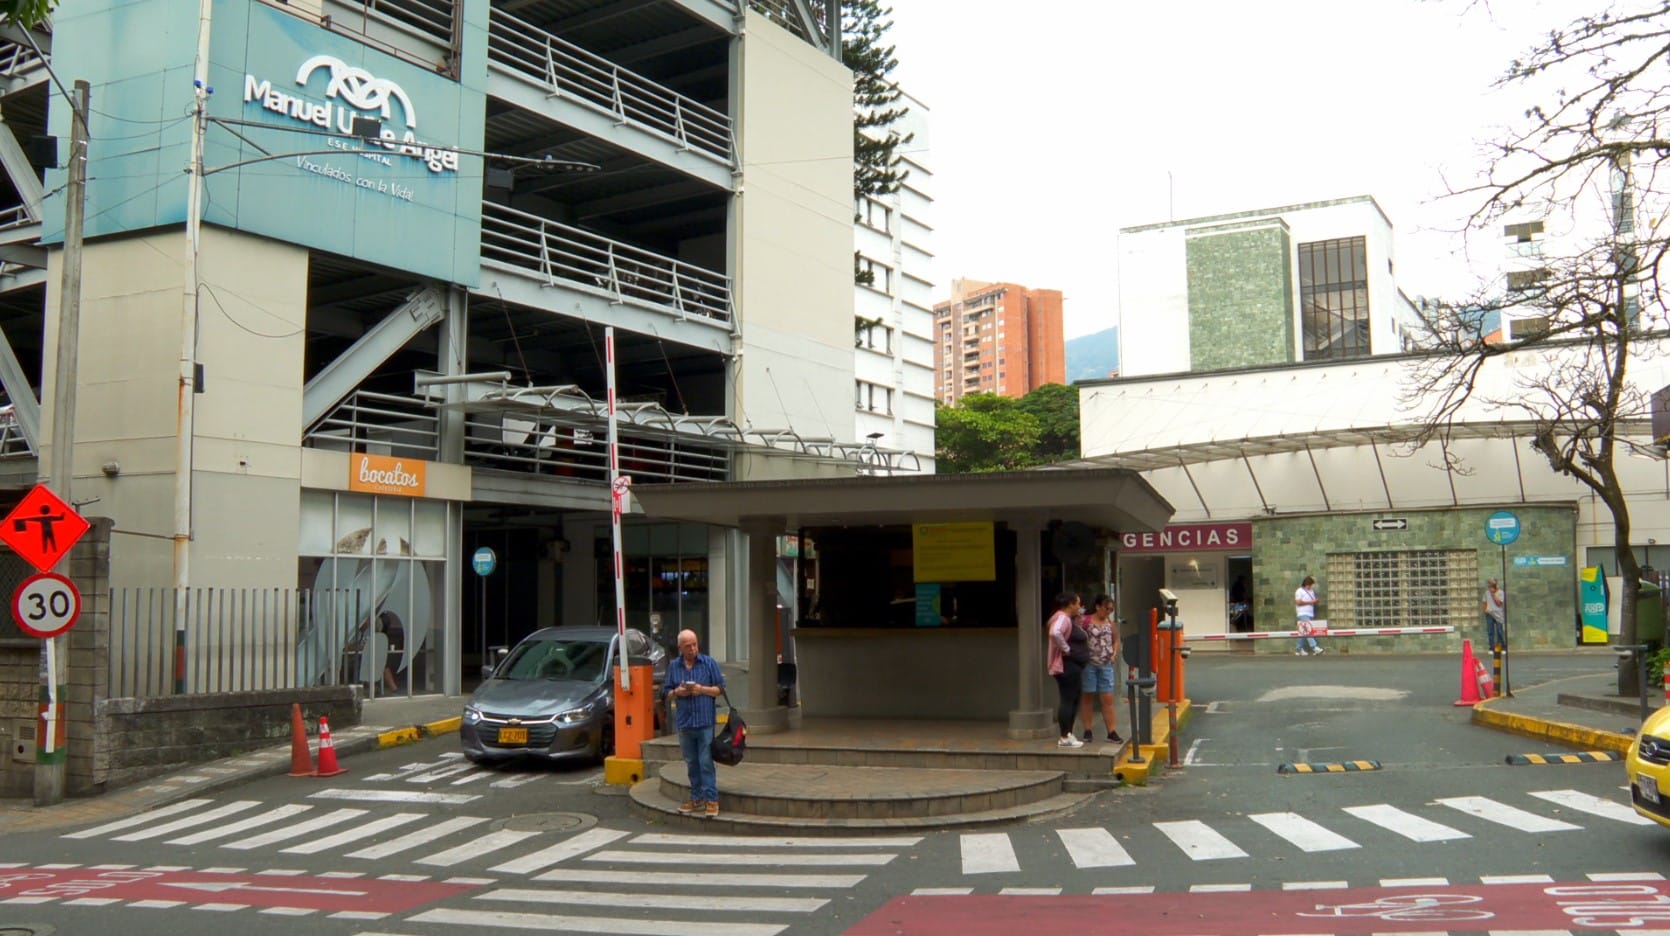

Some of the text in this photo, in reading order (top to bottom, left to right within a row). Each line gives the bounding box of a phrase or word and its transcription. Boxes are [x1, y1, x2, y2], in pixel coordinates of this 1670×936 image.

[243, 74, 333, 129] Manuel
[297, 155, 352, 182] Vinculados
[356, 178, 376, 190] con
[378, 180, 388, 193] la
[359, 456, 419, 487] bocatos
[28, 591, 69, 620] 30
